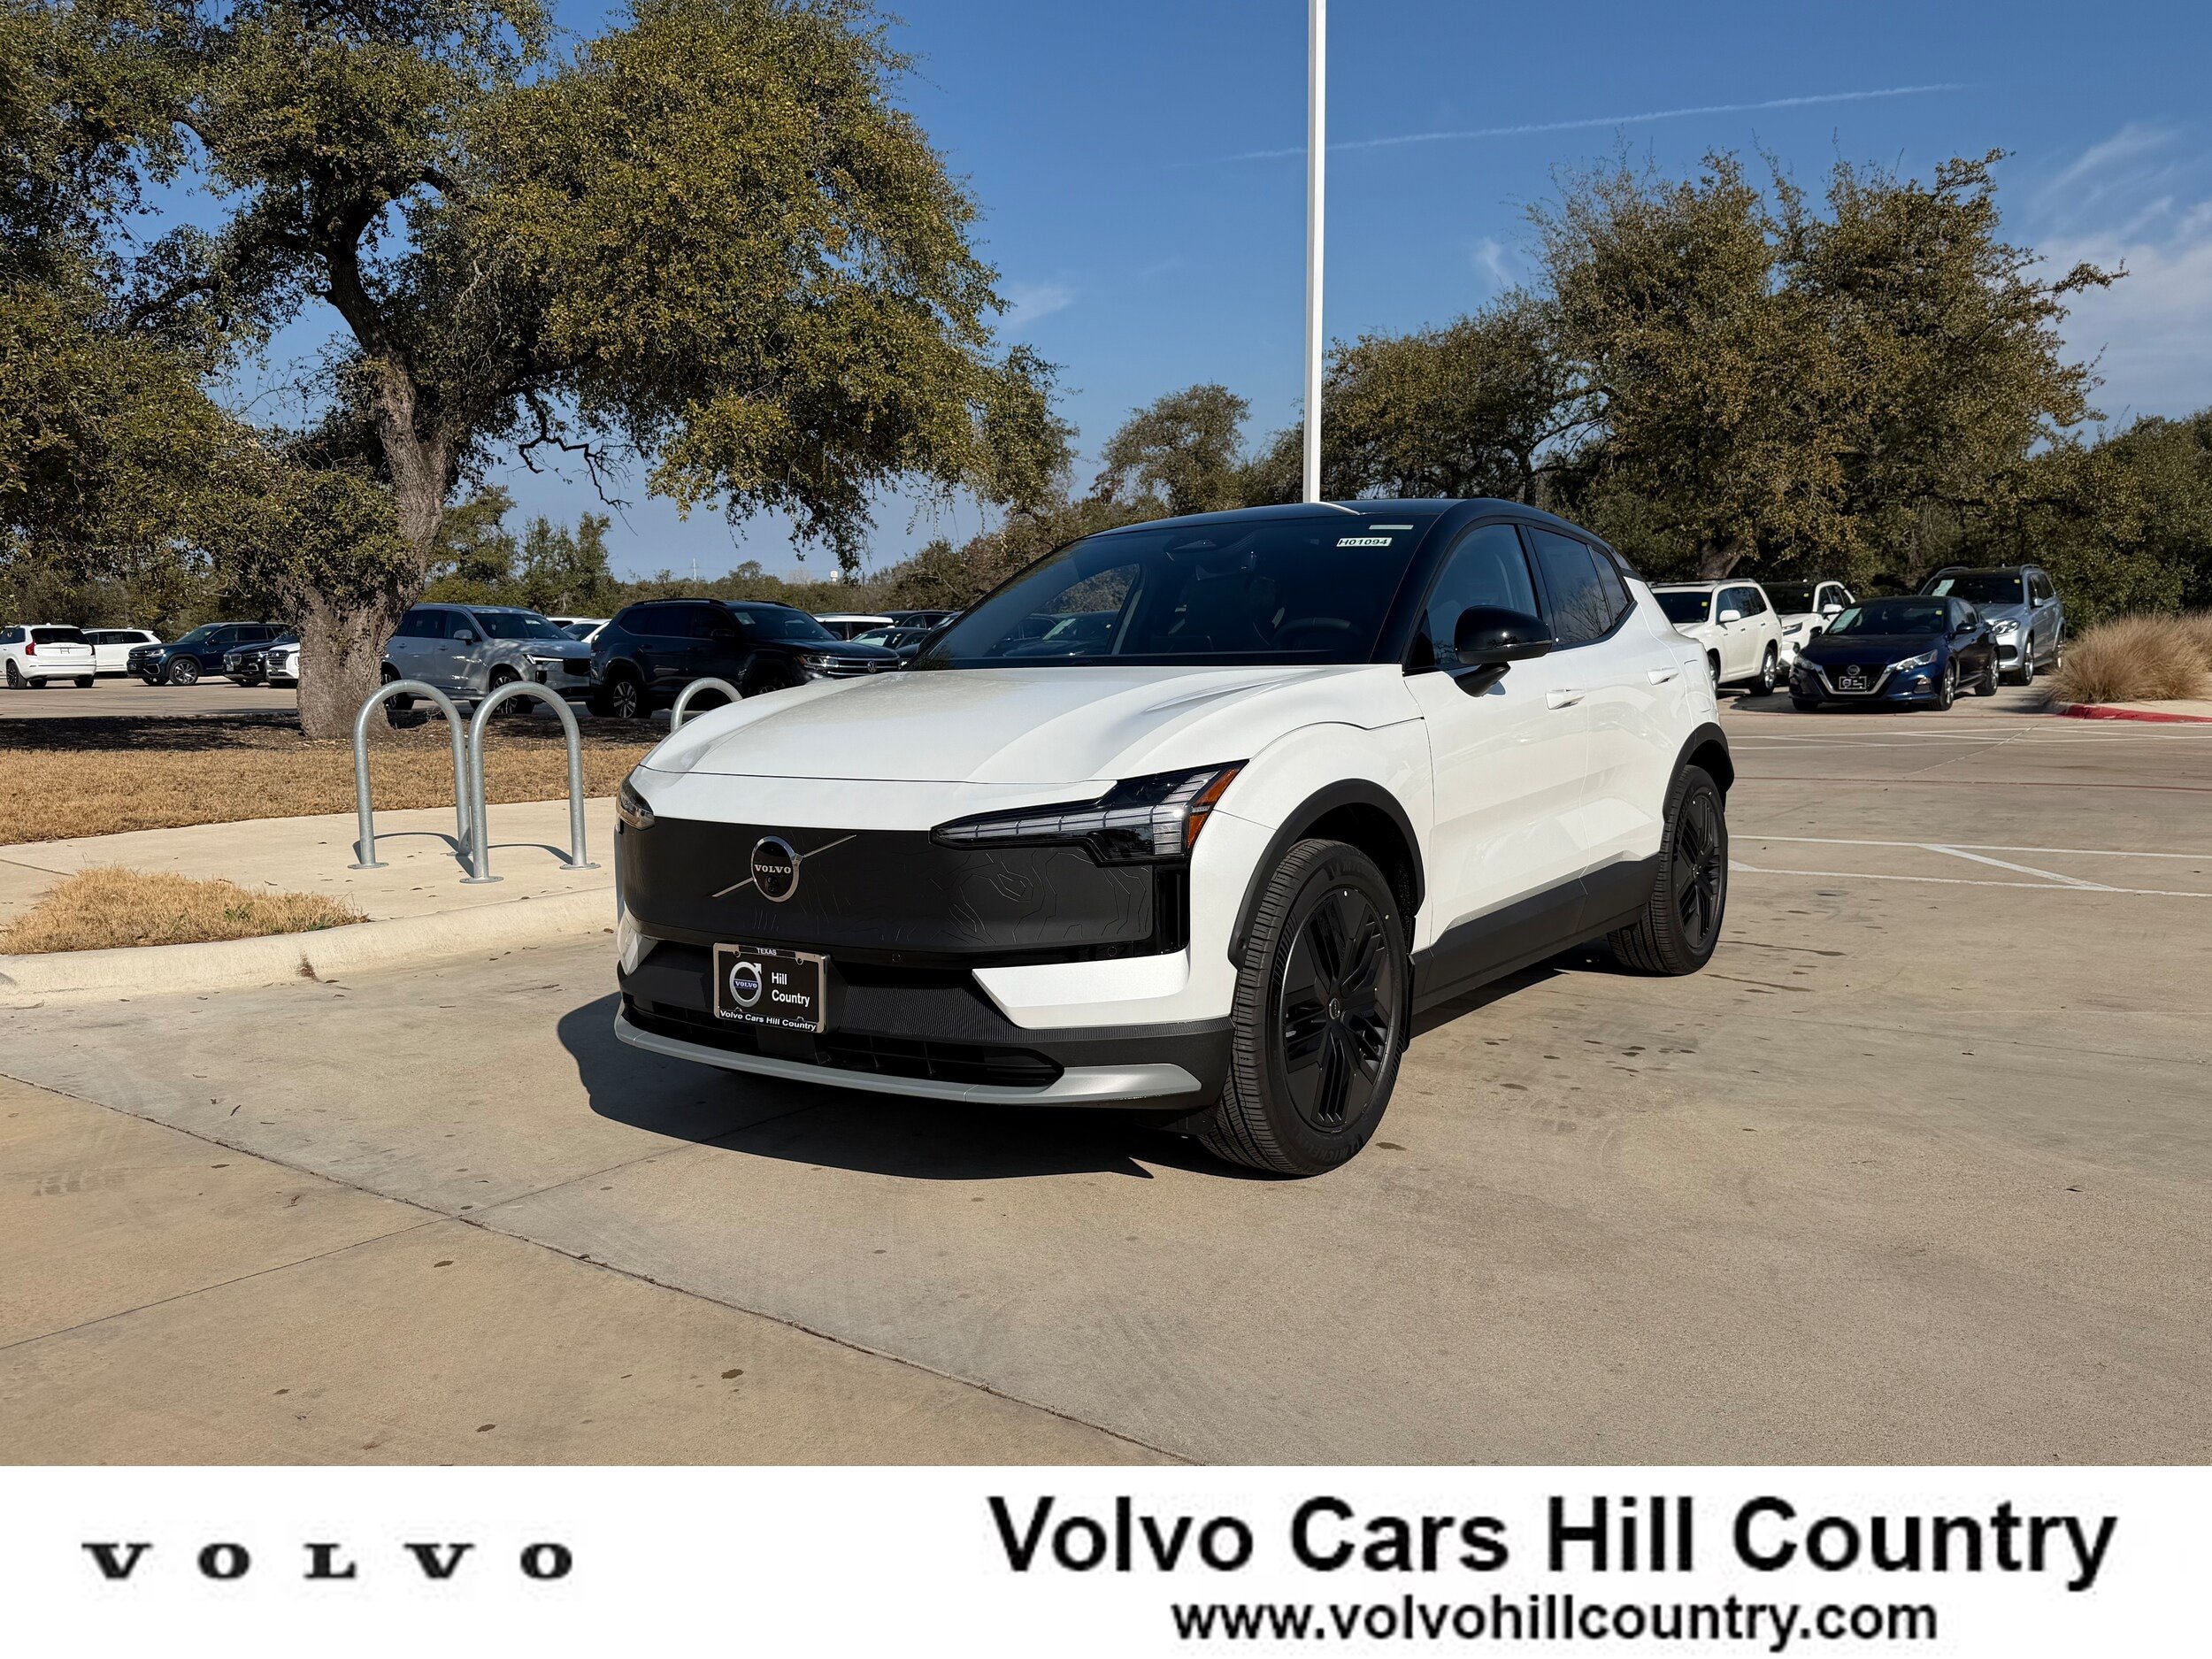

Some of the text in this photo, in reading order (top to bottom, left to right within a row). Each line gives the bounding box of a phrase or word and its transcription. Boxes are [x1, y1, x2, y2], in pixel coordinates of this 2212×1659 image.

[754, 864, 792, 874] VOLVO
[771, 972, 787, 985] Hill
[771, 989, 810, 1008] Country
[719, 1010, 817, 1032] Volvo Cars Hill Country
